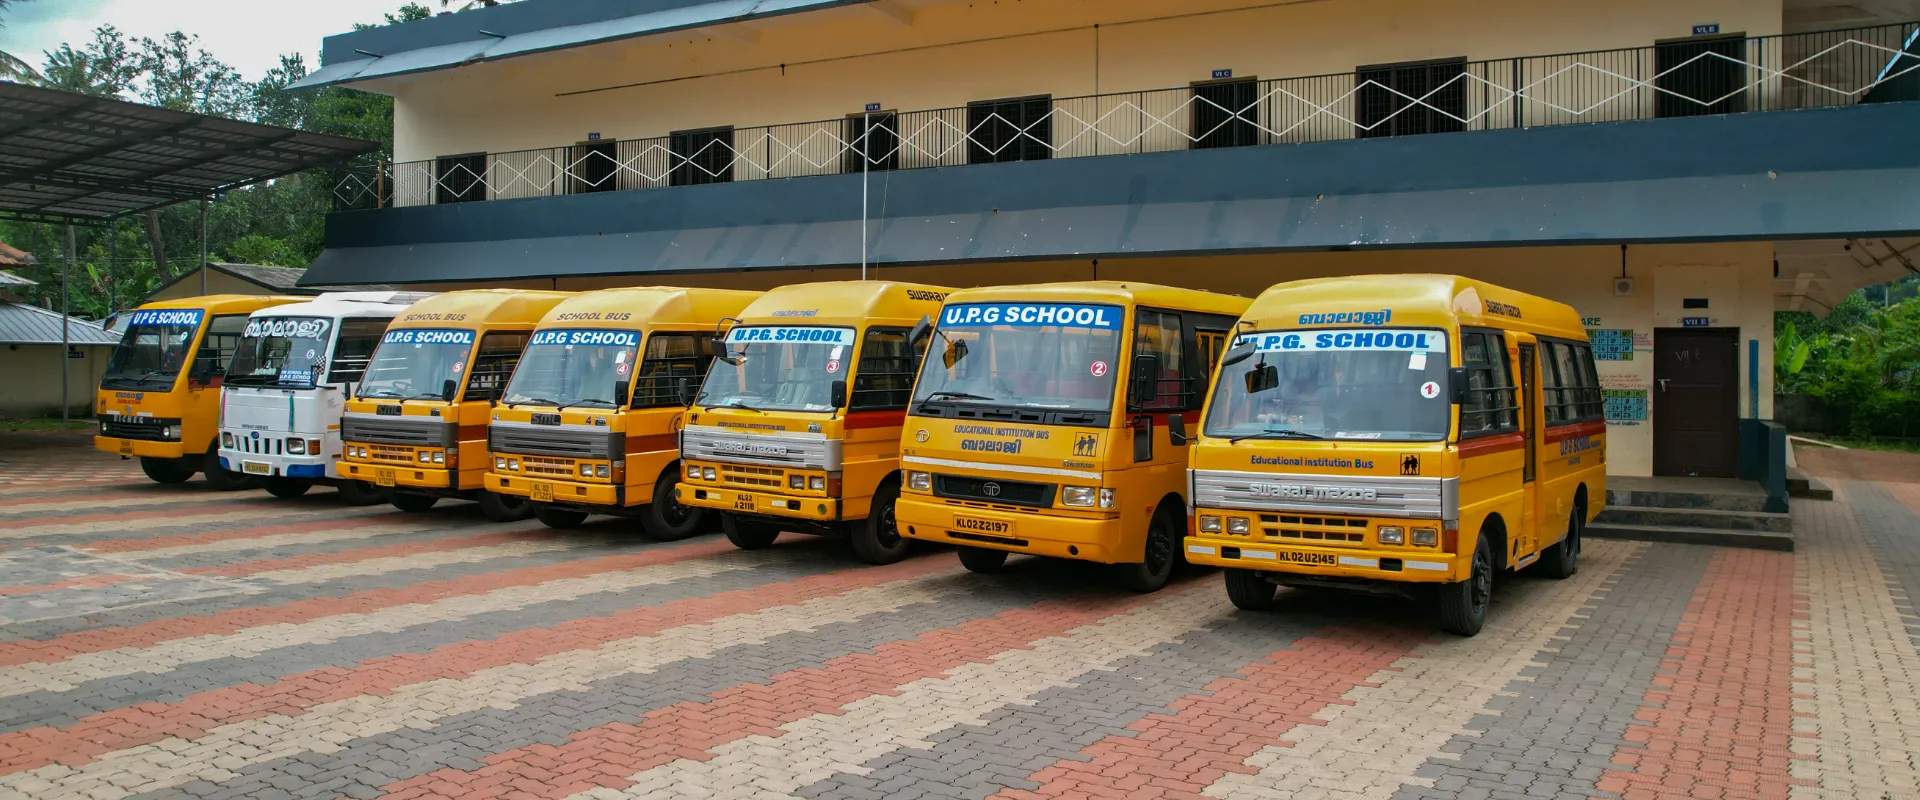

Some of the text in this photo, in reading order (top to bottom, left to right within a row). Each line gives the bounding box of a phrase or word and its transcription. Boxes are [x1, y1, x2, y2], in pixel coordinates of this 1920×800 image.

[156, 311, 199, 325] SCHOOL
[403, 313, 467, 322] SCHOOL BUS
[556, 312, 632, 321] SCHOOL BUS
[946, 307, 1110, 326] U.P.G SCHOOL
[1298, 308, 1392, 326] ബാലാജി
[244, 319, 330, 342] ബാലാജി
[774, 328, 843, 343] SCHOOL
[415, 332, 472, 344] SCHOOL
[533, 332, 637, 346] U.P.G SCHOOL
[1315, 332, 1430, 349] SCHOOL
[1095, 364, 1103, 374] 2
[1424, 384, 1432, 395] 1
[585, 415, 592, 425] 4
[954, 425, 1050, 440] EDUCATIONAL INSTITUTION BUS
[961, 439, 1022, 454] ബാലാജി
[1251, 455, 1374, 469] Educational institution Bus
[737, 494, 753, 502] KL22
[739, 502, 755, 510] 2118
[956, 518, 1009, 533] KL02Z2197
[1279, 551, 1335, 565] KL02U2145
